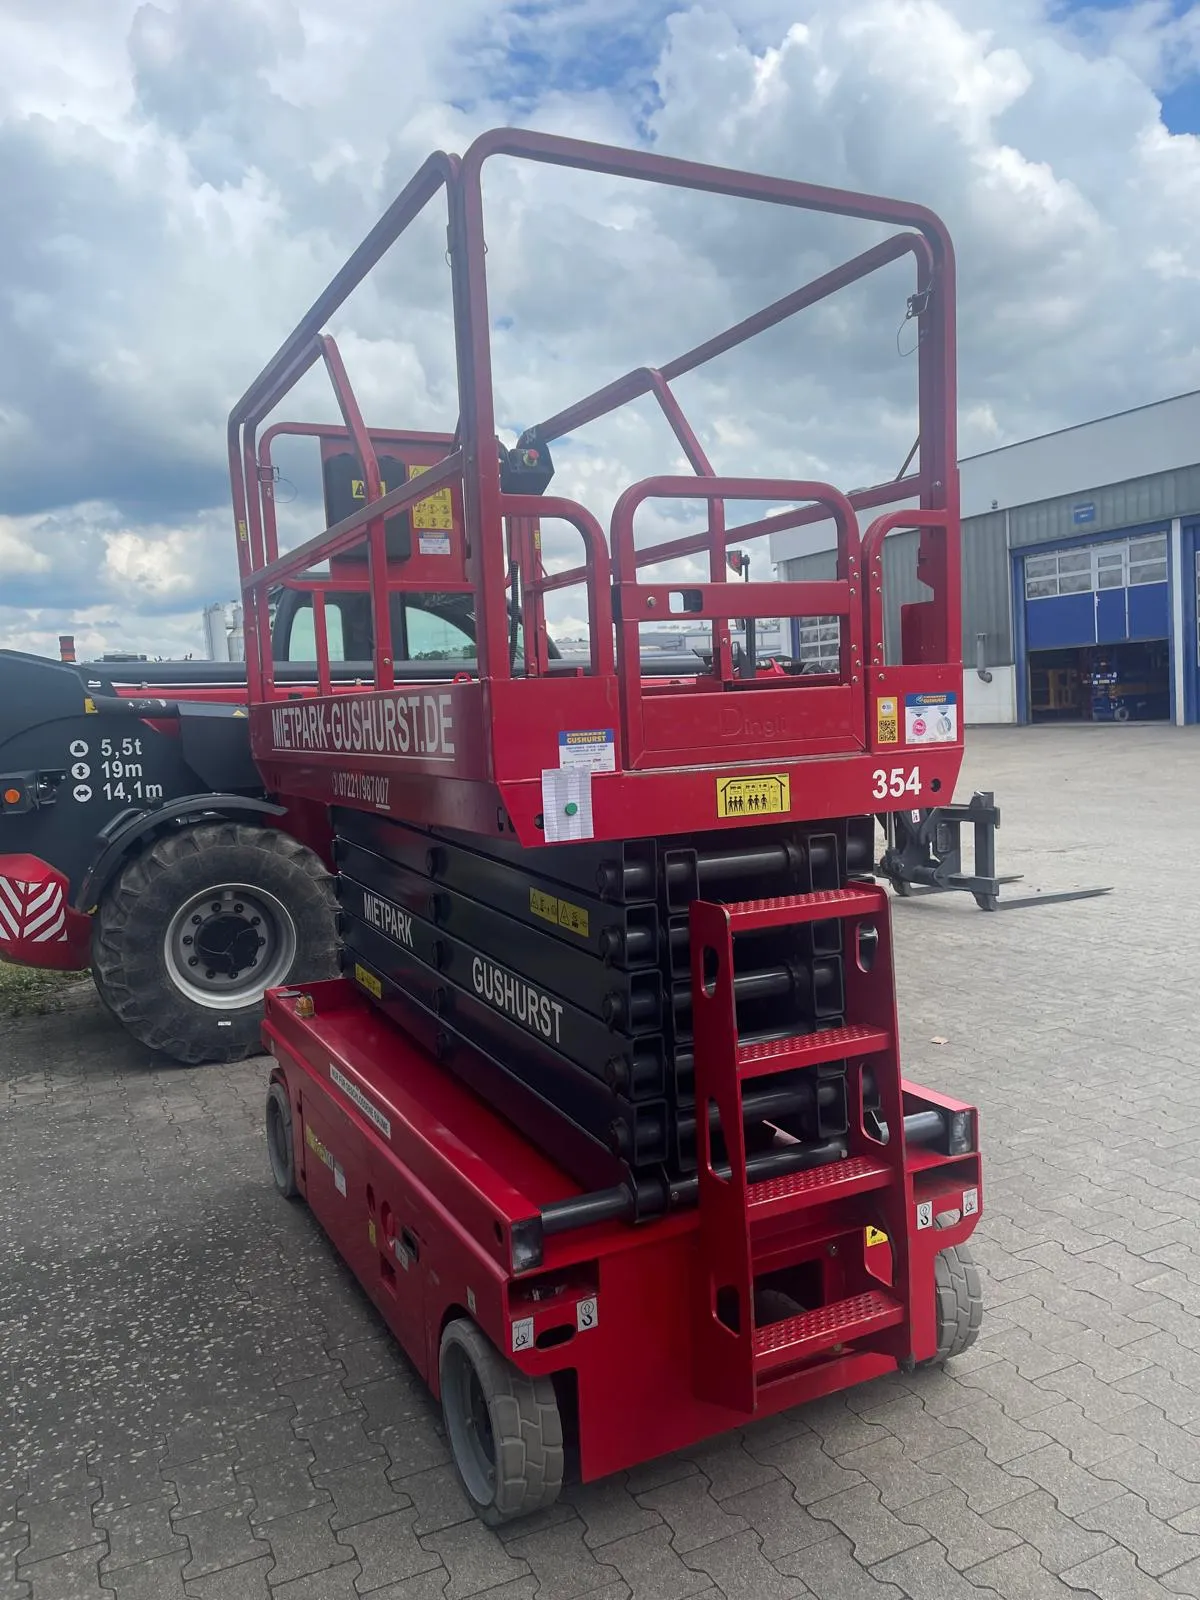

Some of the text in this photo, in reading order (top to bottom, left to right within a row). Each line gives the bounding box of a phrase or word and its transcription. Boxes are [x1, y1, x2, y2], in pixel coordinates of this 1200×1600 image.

[272, 694, 455, 754] MIETPARK-GUSHURST.DE
[101, 738, 142, 759] 5,5t
[566, 736, 606, 744] GUSHURST
[101, 760, 143, 779] 19m
[872, 766, 922, 799] 354
[103, 781, 163, 802] 14,1m
[363, 892, 414, 947] MIETPARK
[472, 956, 563, 1043] GUSHURST
